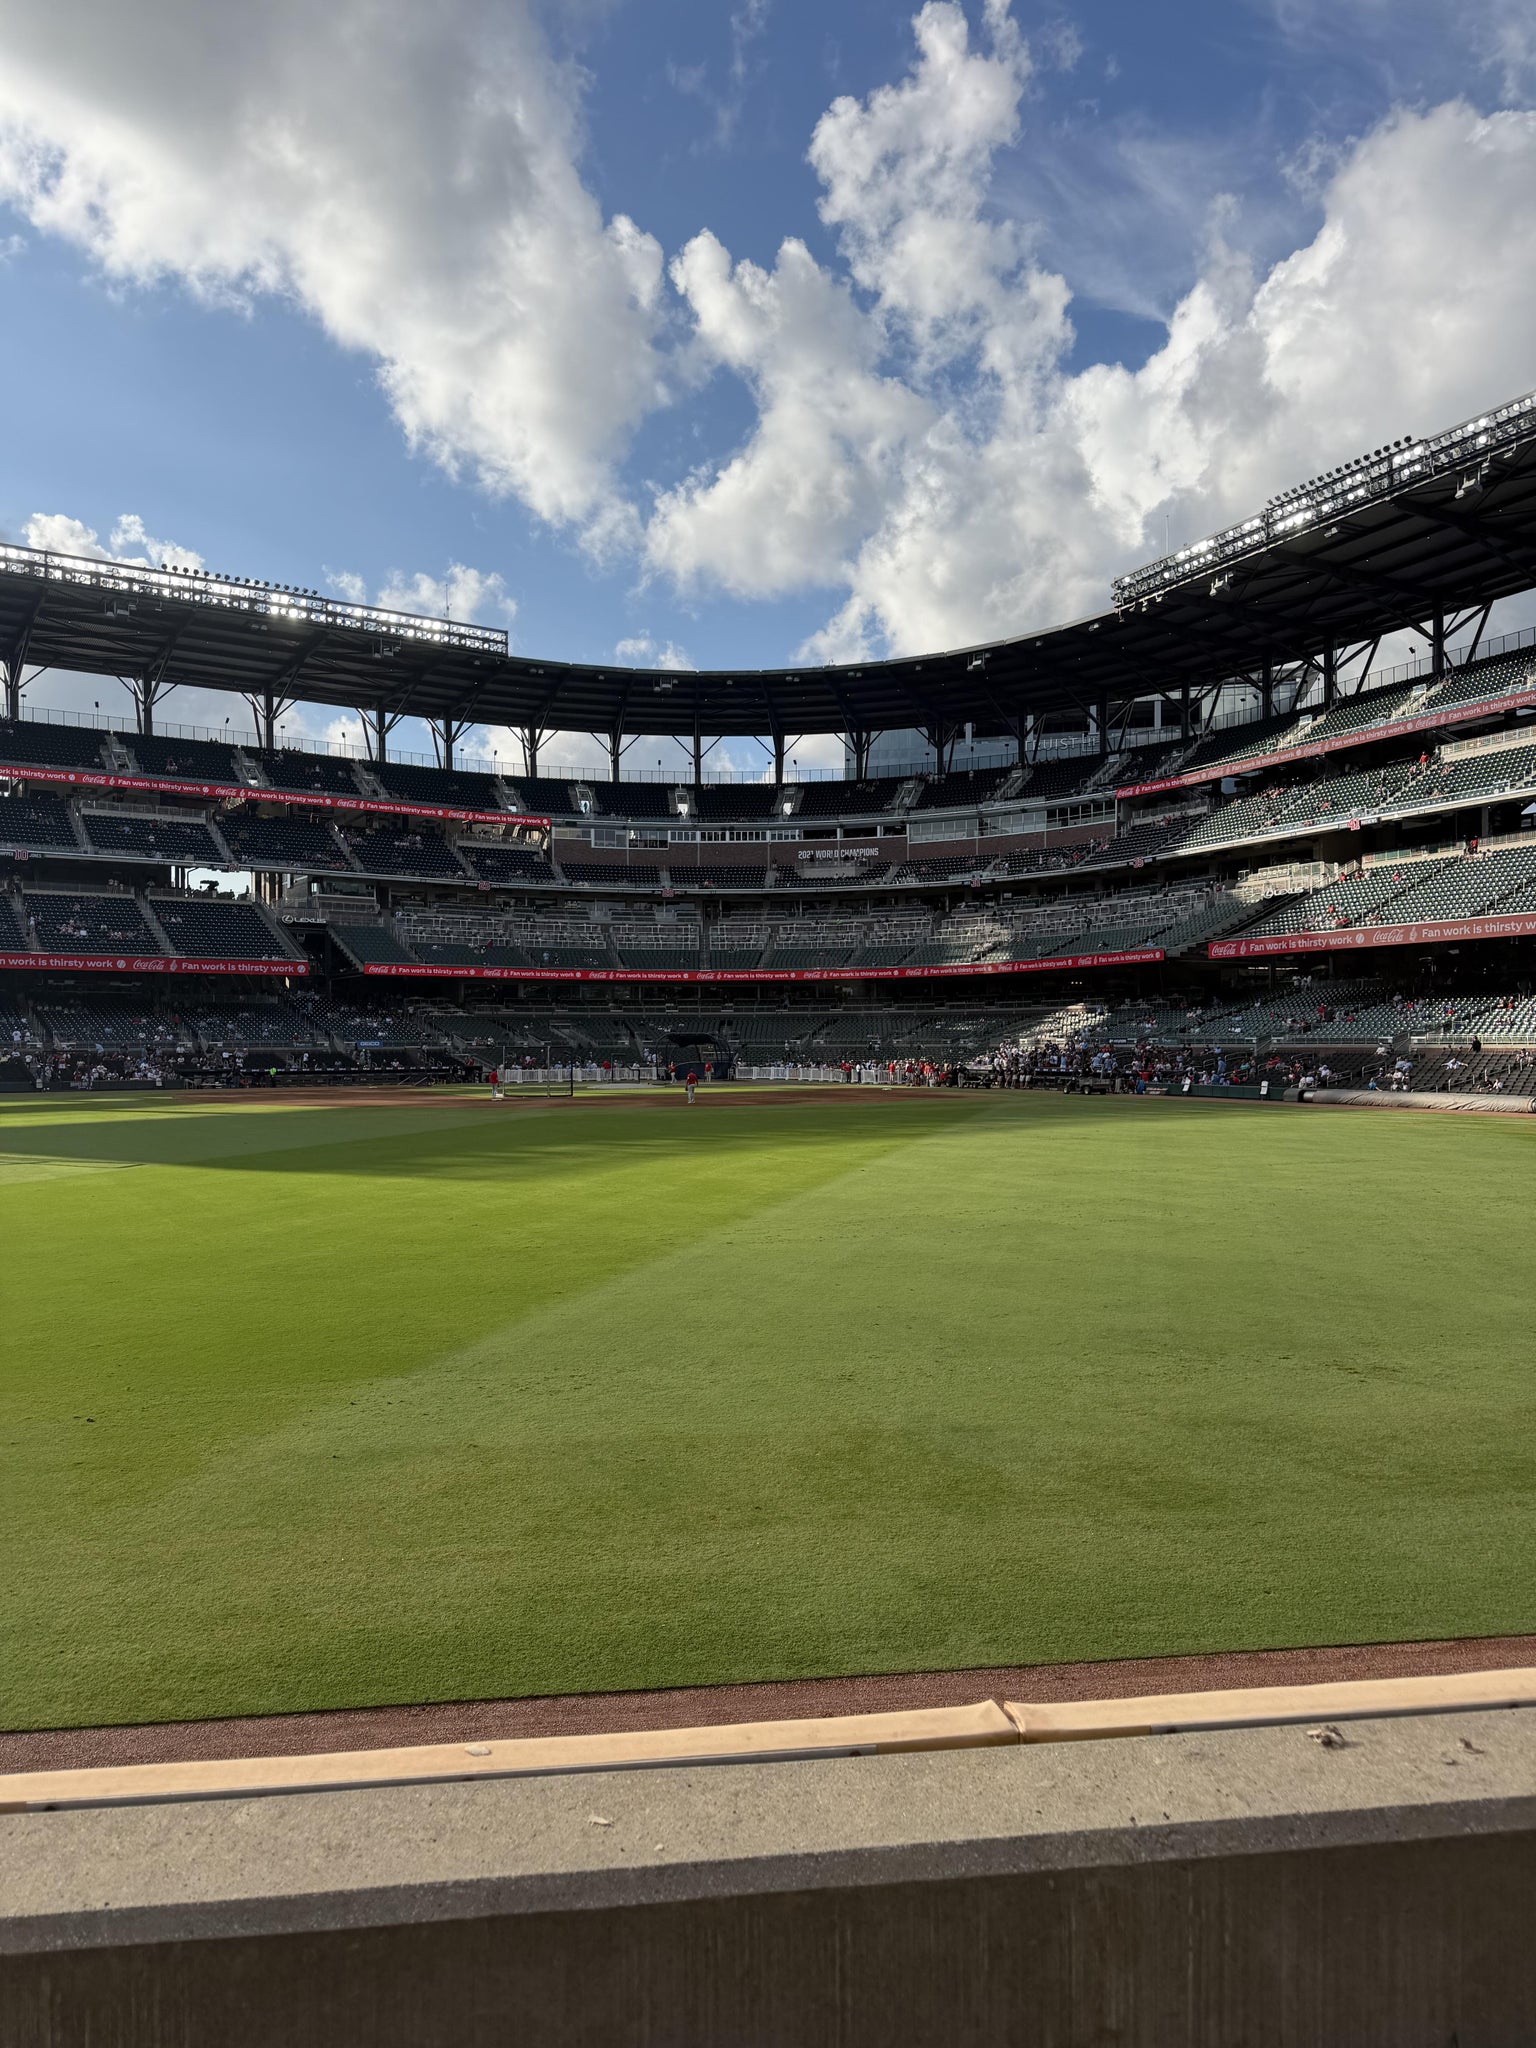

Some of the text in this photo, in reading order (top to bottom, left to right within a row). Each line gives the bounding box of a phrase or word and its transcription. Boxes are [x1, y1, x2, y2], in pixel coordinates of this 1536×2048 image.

[20, 770, 46, 779] thirsty
[158, 782, 182, 791] thirsty
[285, 795, 307, 803] thirsty
[841, 848, 879, 857] CHAMPIONS
[1422, 928, 1440, 938] Fan
[1443, 925, 1470, 936] work
[1473, 924, 1482, 934] is
[1484, 921, 1523, 933] thirsty
[1250, 943, 1264, 952] Fan
[1266, 941, 1287, 950] work
[1289, 940, 1296, 948] is
[1298, 938, 1327, 948] thirsty
[1329, 935, 1352, 945] work
[8, 957, 36, 966] work
[38, 958, 47, 966] is
[50, 958, 84, 968] thirsty
[87, 959, 113, 968] work
[182, 962, 199, 970] Fan
[228, 963, 236, 971] is
[238, 963, 269, 973] thirsty
[270, 965, 294, 973] work
